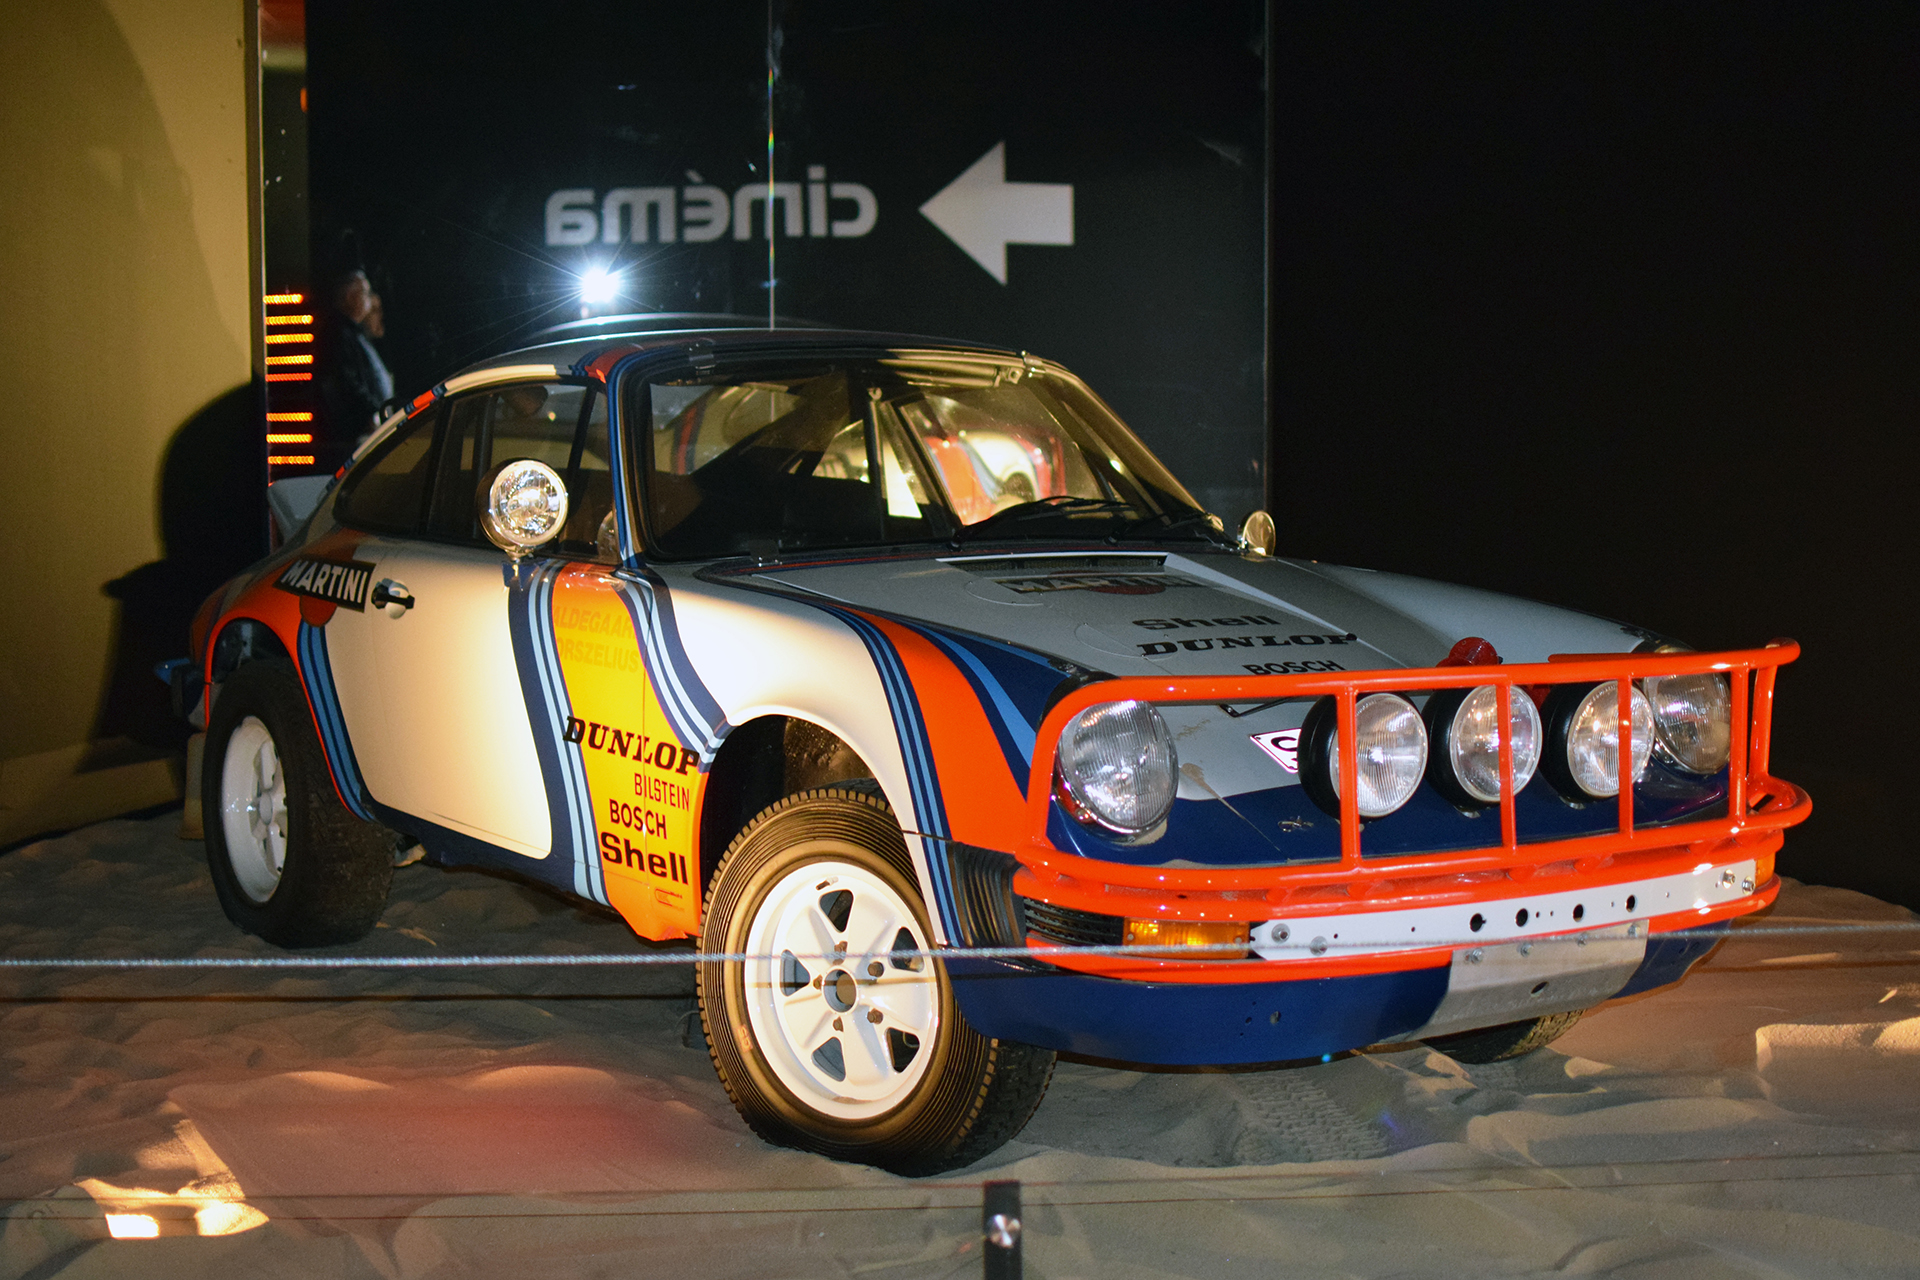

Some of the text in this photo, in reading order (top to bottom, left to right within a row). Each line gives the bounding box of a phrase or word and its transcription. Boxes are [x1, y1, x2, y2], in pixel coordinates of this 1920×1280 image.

[278, 559, 369, 604] MARTINI
[554, 605, 636, 640] ALDEGAAR
[1132, 615, 1282, 631] Shell
[1242, 660, 1346, 676] BOSCH
[562, 715, 700, 776] DUNLOP
[634, 772, 690, 812] BILSTEIN
[609, 798, 667, 840] BOSCH
[600, 831, 689, 886] Shell
